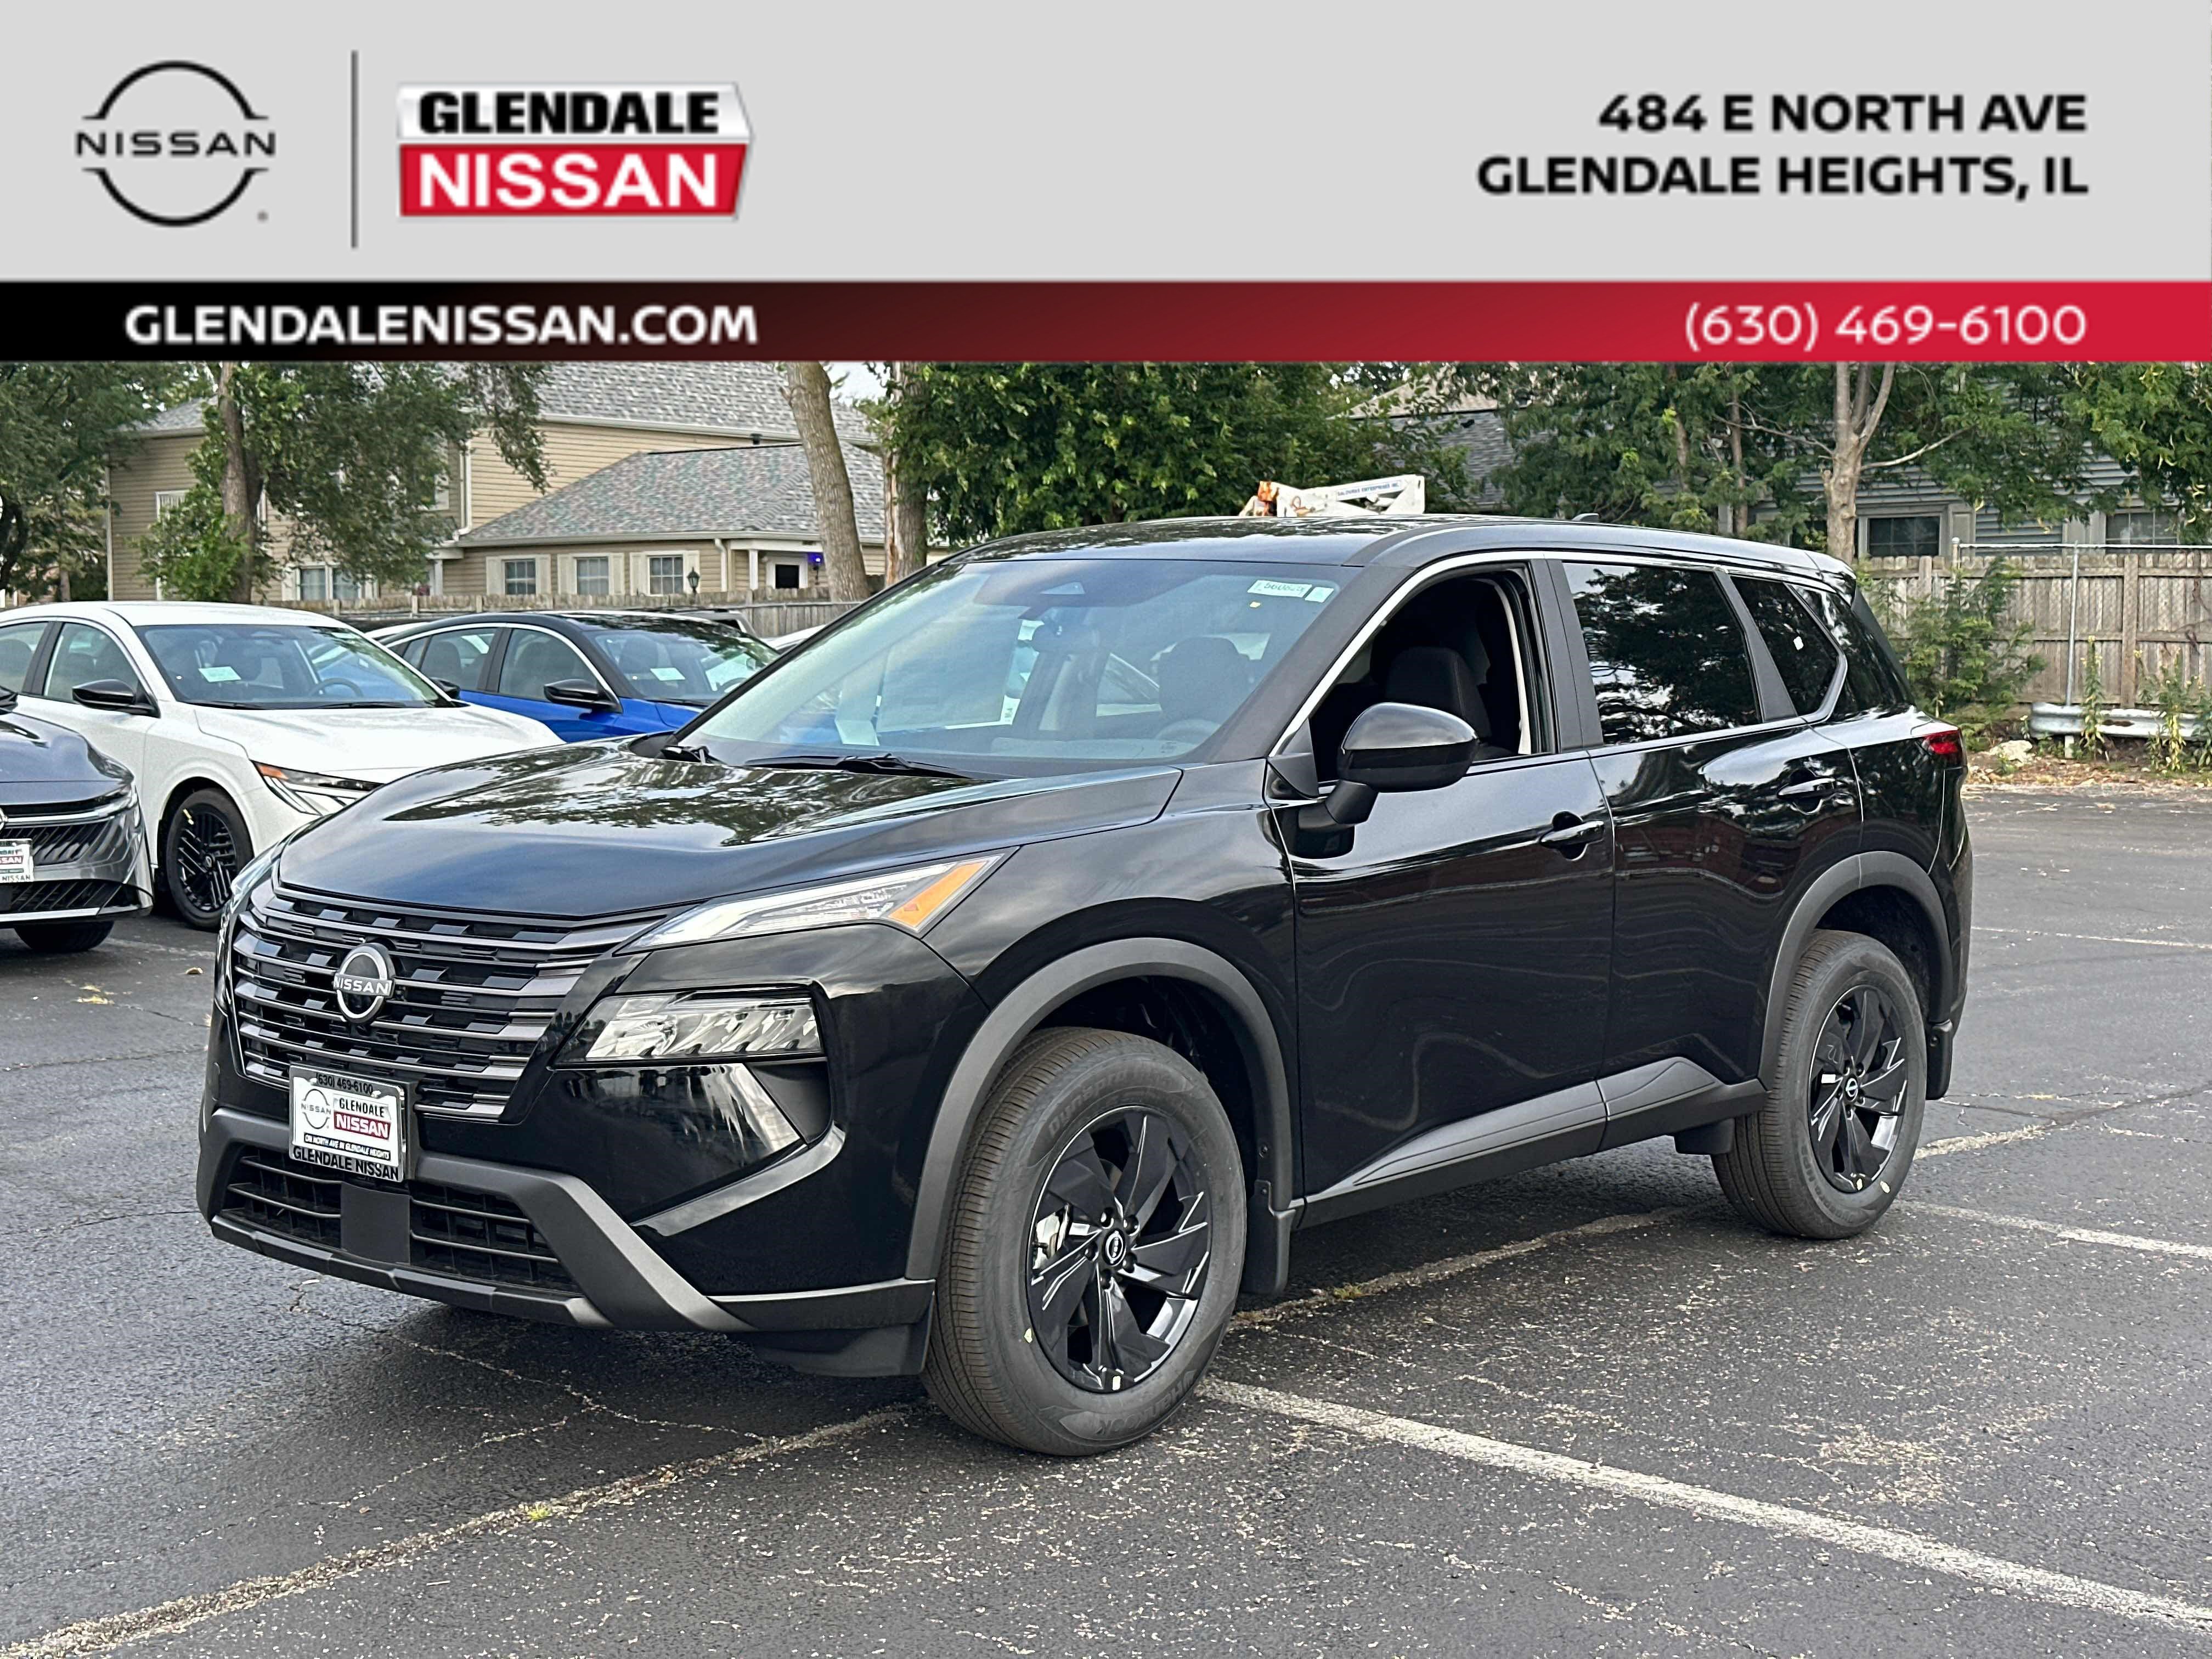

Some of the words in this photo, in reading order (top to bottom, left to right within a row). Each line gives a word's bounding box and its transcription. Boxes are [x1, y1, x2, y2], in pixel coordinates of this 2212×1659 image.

[334, 975, 390, 995] NISSAN
[316, 1073, 335, 1085] (630)
[337, 1079, 374, 1095] 469-6100
[301, 1103, 331, 1115] NISSAN
[339, 1097, 385, 1118] GLENDALE
[335, 1114, 388, 1138] NISSAN
[294, 1147, 352, 1171] GLENDALE
[356, 1160, 399, 1181] NISSAN
